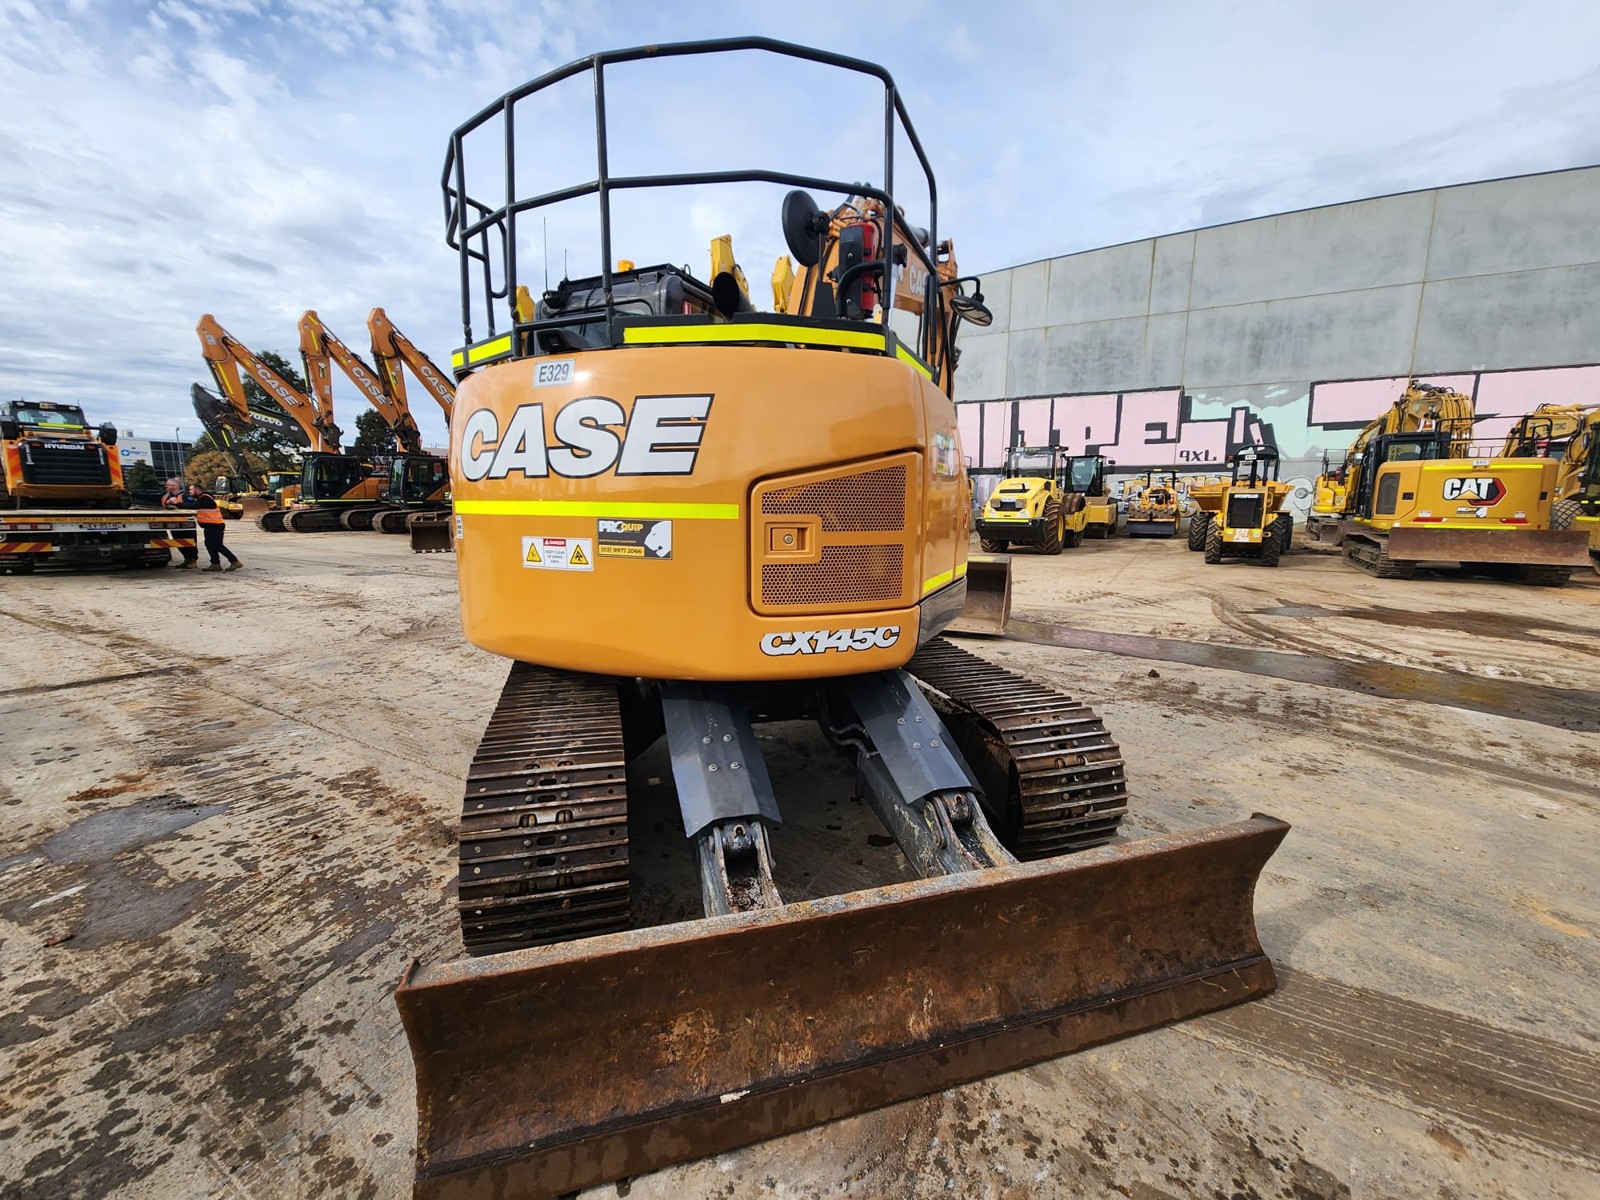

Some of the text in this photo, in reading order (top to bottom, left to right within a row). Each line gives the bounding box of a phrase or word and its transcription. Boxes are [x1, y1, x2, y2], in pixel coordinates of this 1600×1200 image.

[257, 366, 299, 406] CASE
[352, 366, 386, 404] CASE
[421, 365, 454, 404] CASE
[538, 363, 570, 383] E329
[461, 393, 716, 482] CASE
[1443, 477, 1494, 500] CAT
[759, 626, 901, 657] CX145C
